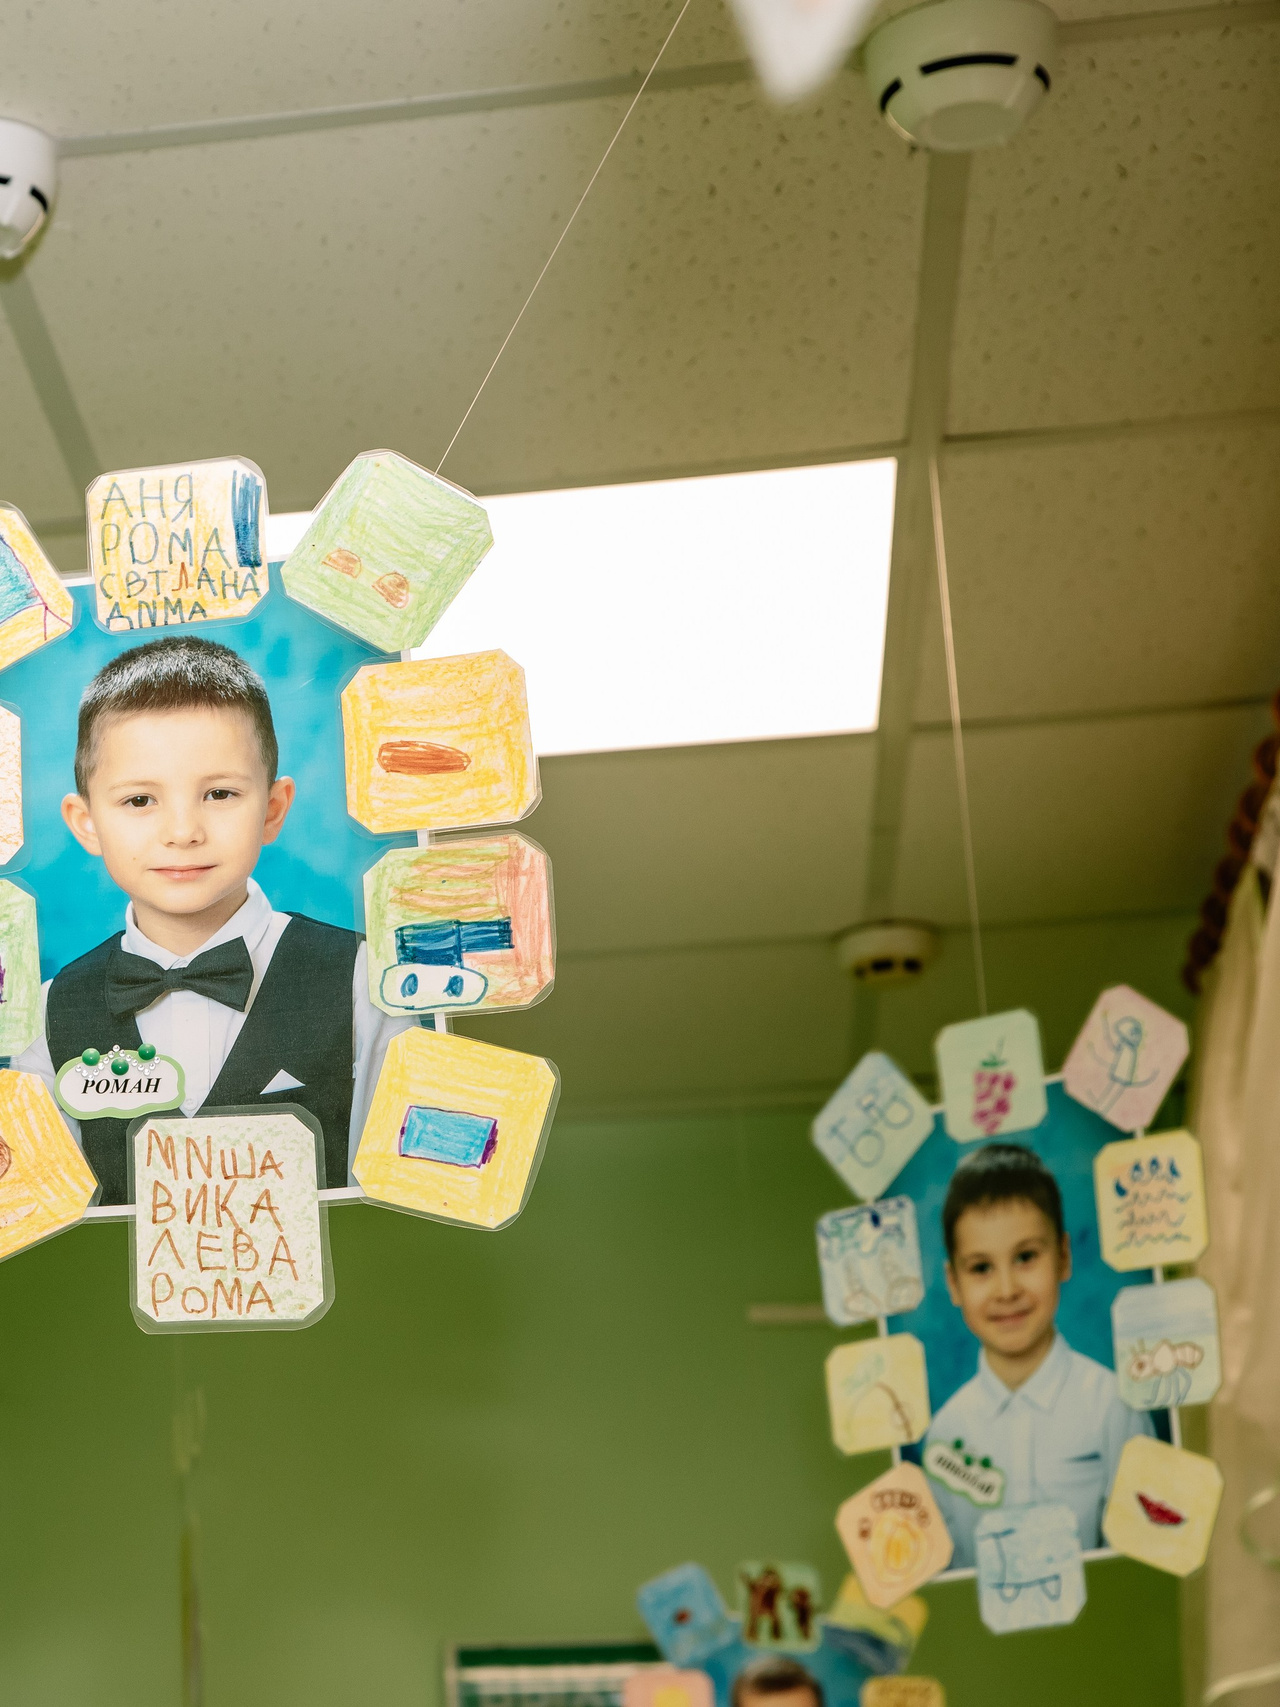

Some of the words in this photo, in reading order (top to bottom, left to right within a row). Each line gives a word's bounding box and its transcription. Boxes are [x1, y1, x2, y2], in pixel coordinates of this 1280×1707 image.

[100, 471, 194, 523] АНЯ
[101, 521, 232, 570] РОМА
[81, 1077, 162, 1094] РОМАН
[152, 1179, 285, 1233] ВИКА
[147, 1227, 299, 1281] ЛЕВА
[151, 1272, 276, 1319] РОМА
